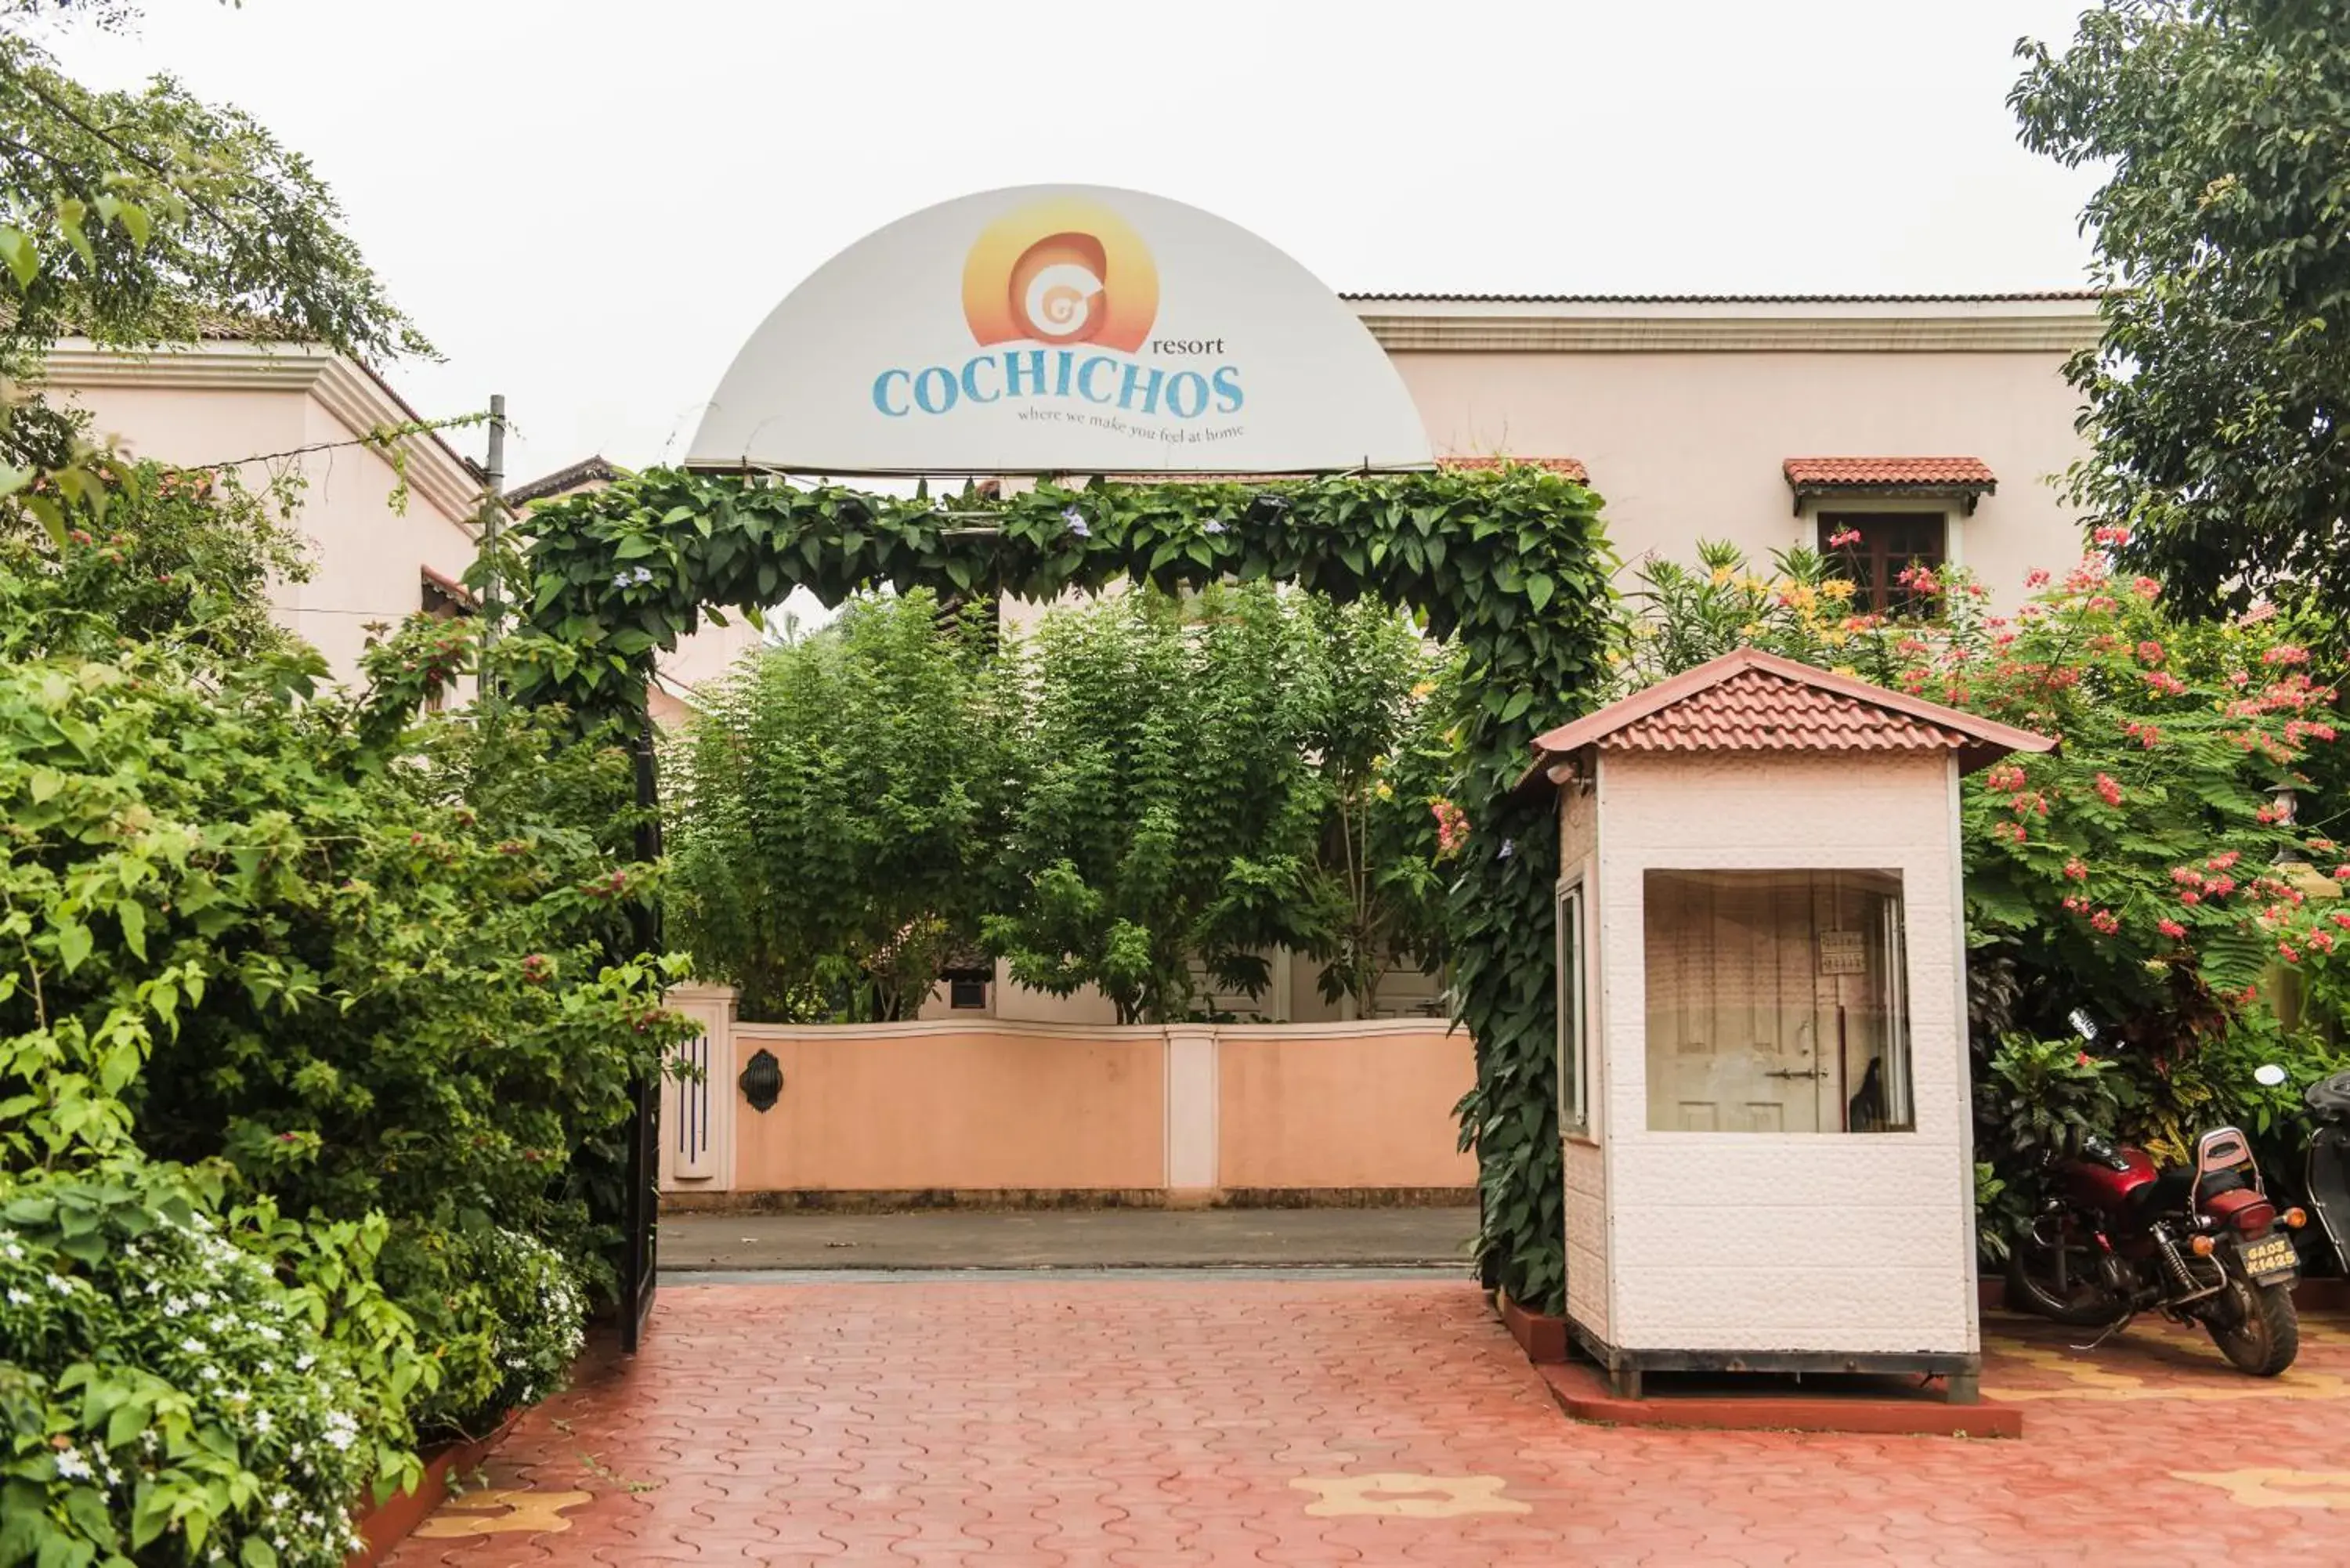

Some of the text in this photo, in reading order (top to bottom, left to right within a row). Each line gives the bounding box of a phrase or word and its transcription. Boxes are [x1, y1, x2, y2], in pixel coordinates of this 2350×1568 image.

[1152, 337, 1224, 355] resort
[872, 349, 1244, 418] COCHICHOS
[1018, 406, 1245, 443] where we make you feel at home
[2248, 1240, 2285, 1259] GA03
